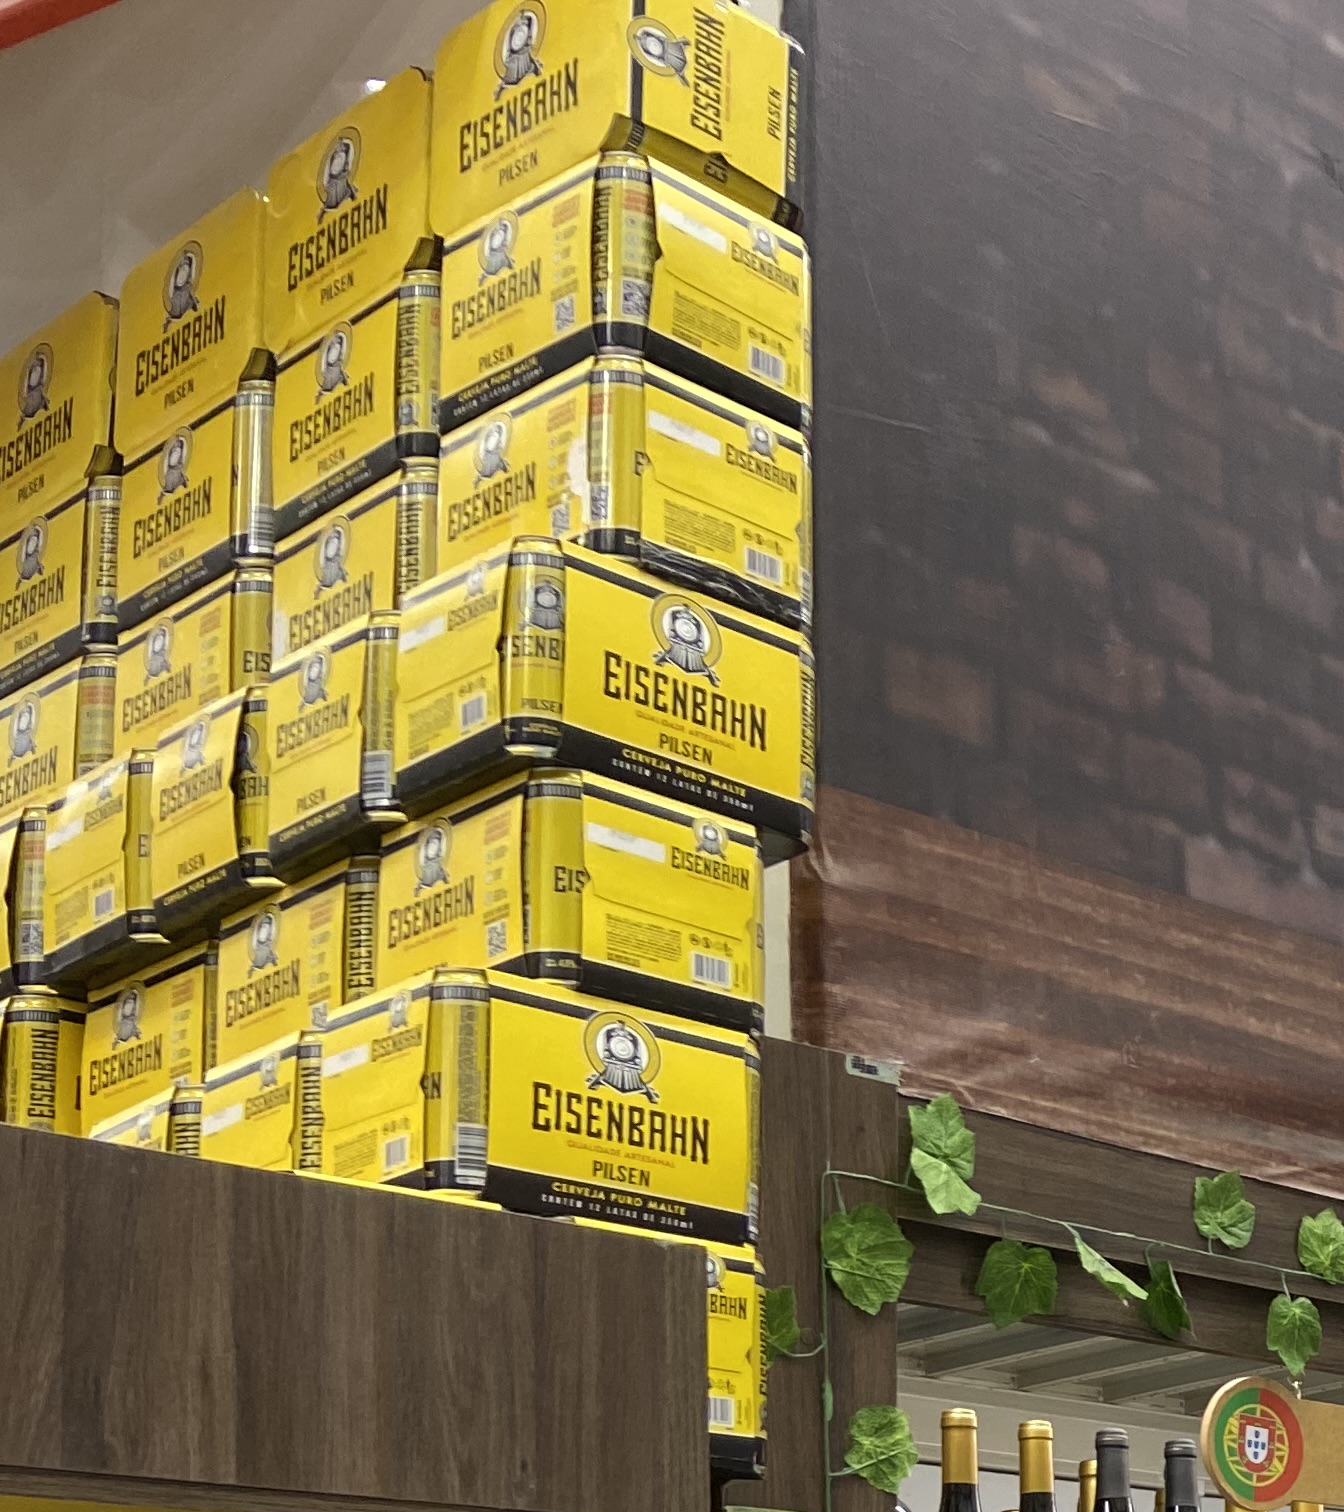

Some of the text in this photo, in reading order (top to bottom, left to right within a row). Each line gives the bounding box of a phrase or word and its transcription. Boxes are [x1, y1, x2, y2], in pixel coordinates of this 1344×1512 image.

[691, 8, 725, 140] EISENBAHN
[459, 58, 580, 173] EISENBAHN
[499, 151, 538, 185] PILSEN
[287, 183, 388, 292] EISENBAHN
[452, 258, 541, 340] EISENBAHN
[135, 295, 226, 397] EISENBAHN
[479, 343, 514, 372] PILSEN
[290, 373, 374, 462] EISENBAHN
[447, 462, 537, 542] EISENBAHN
[726, 444, 798, 495] EISENBAHN
[134, 477, 212, 559] EISENBAHN
[123, 665, 191, 733] EISENBAHN
[277, 693, 349, 759] EISENBAHN
[604, 651, 767, 752] EISENBAHN
[659, 733, 714, 766] PILSEN
[671, 846, 750, 891] EISENBAHN
[388, 876, 474, 949] EISENBAHN
[226, 958, 301, 1027] EISENBAHN
[29, 1028, 58, 1119] EISENBAHN
[89, 1034, 162, 1096] EISENBAHN
[532, 1082, 710, 1164] EISENBAHN
[566, 1139, 622, 1158] QUALIDADE
[551, 1182, 686, 1216] CERVEJA PURO MALTE
[592, 1160, 651, 1187] PILSEN
